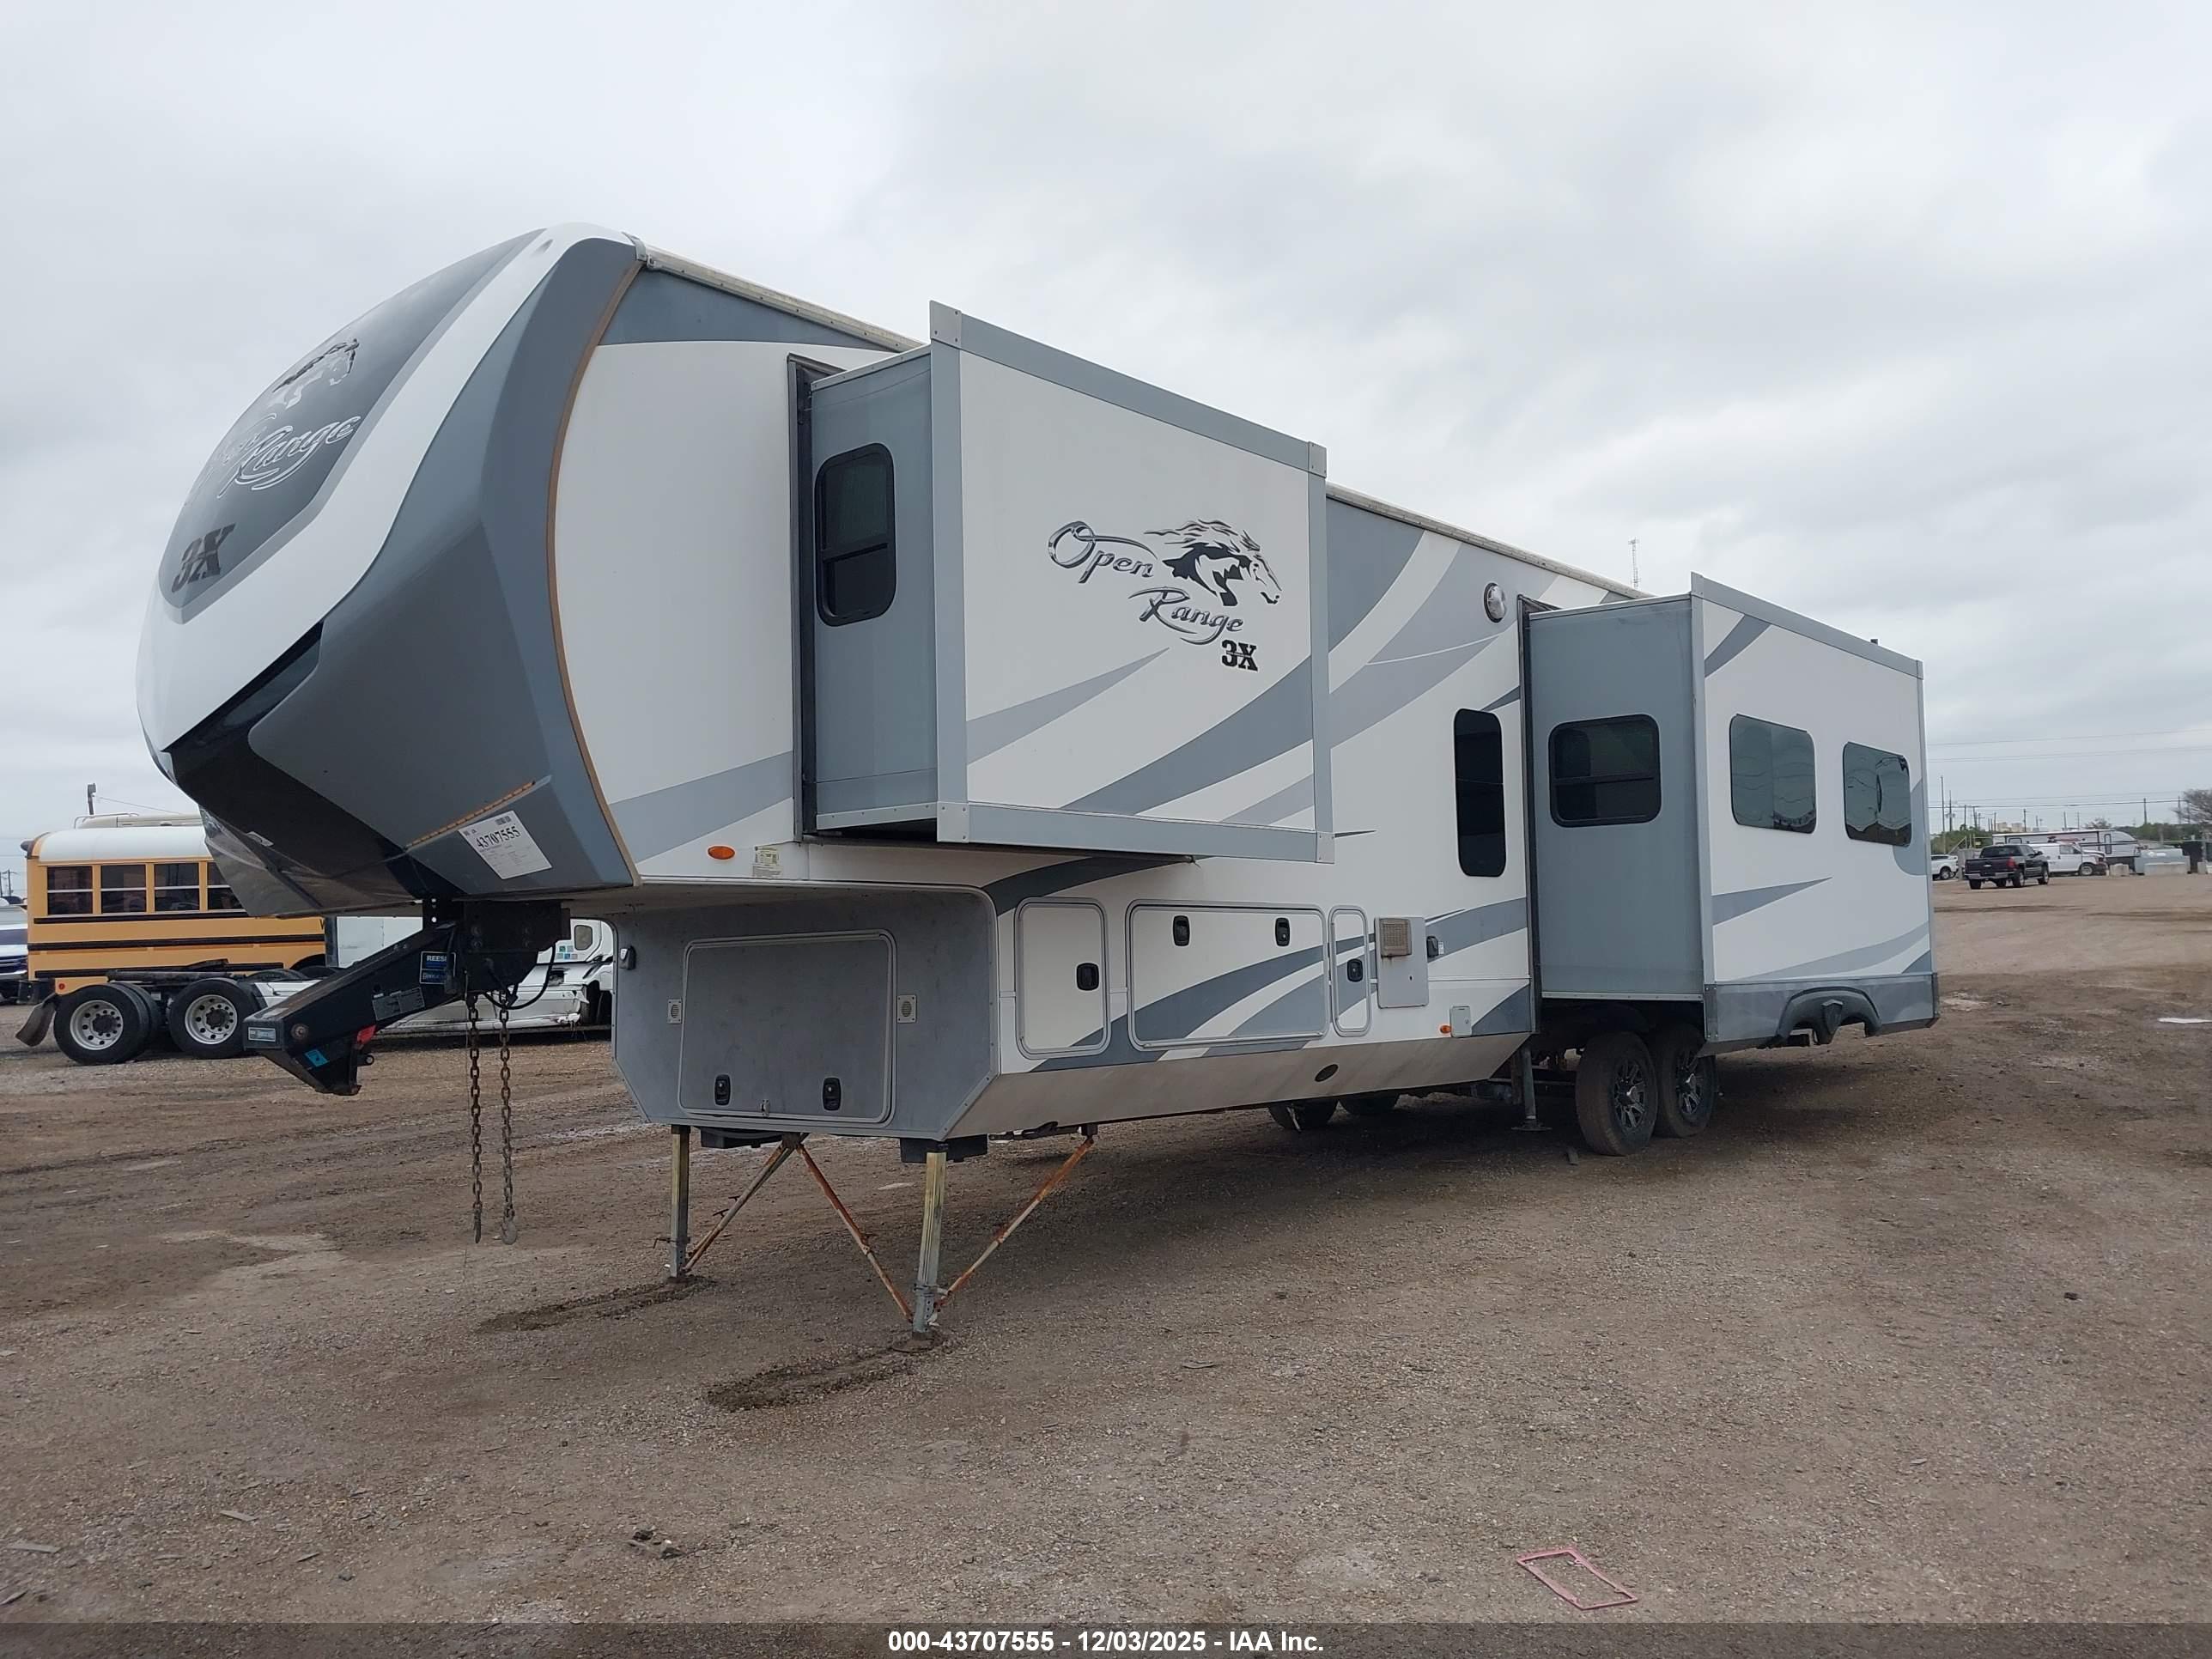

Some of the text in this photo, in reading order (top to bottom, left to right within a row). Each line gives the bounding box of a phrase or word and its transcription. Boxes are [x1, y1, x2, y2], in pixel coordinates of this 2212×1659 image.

[171, 522, 236, 592] 3X
[1048, 520, 1158, 584] Open
[1127, 586, 1244, 646] Range
[1220, 639, 1259, 672] 3X
[476, 824, 520, 849] 43707555
